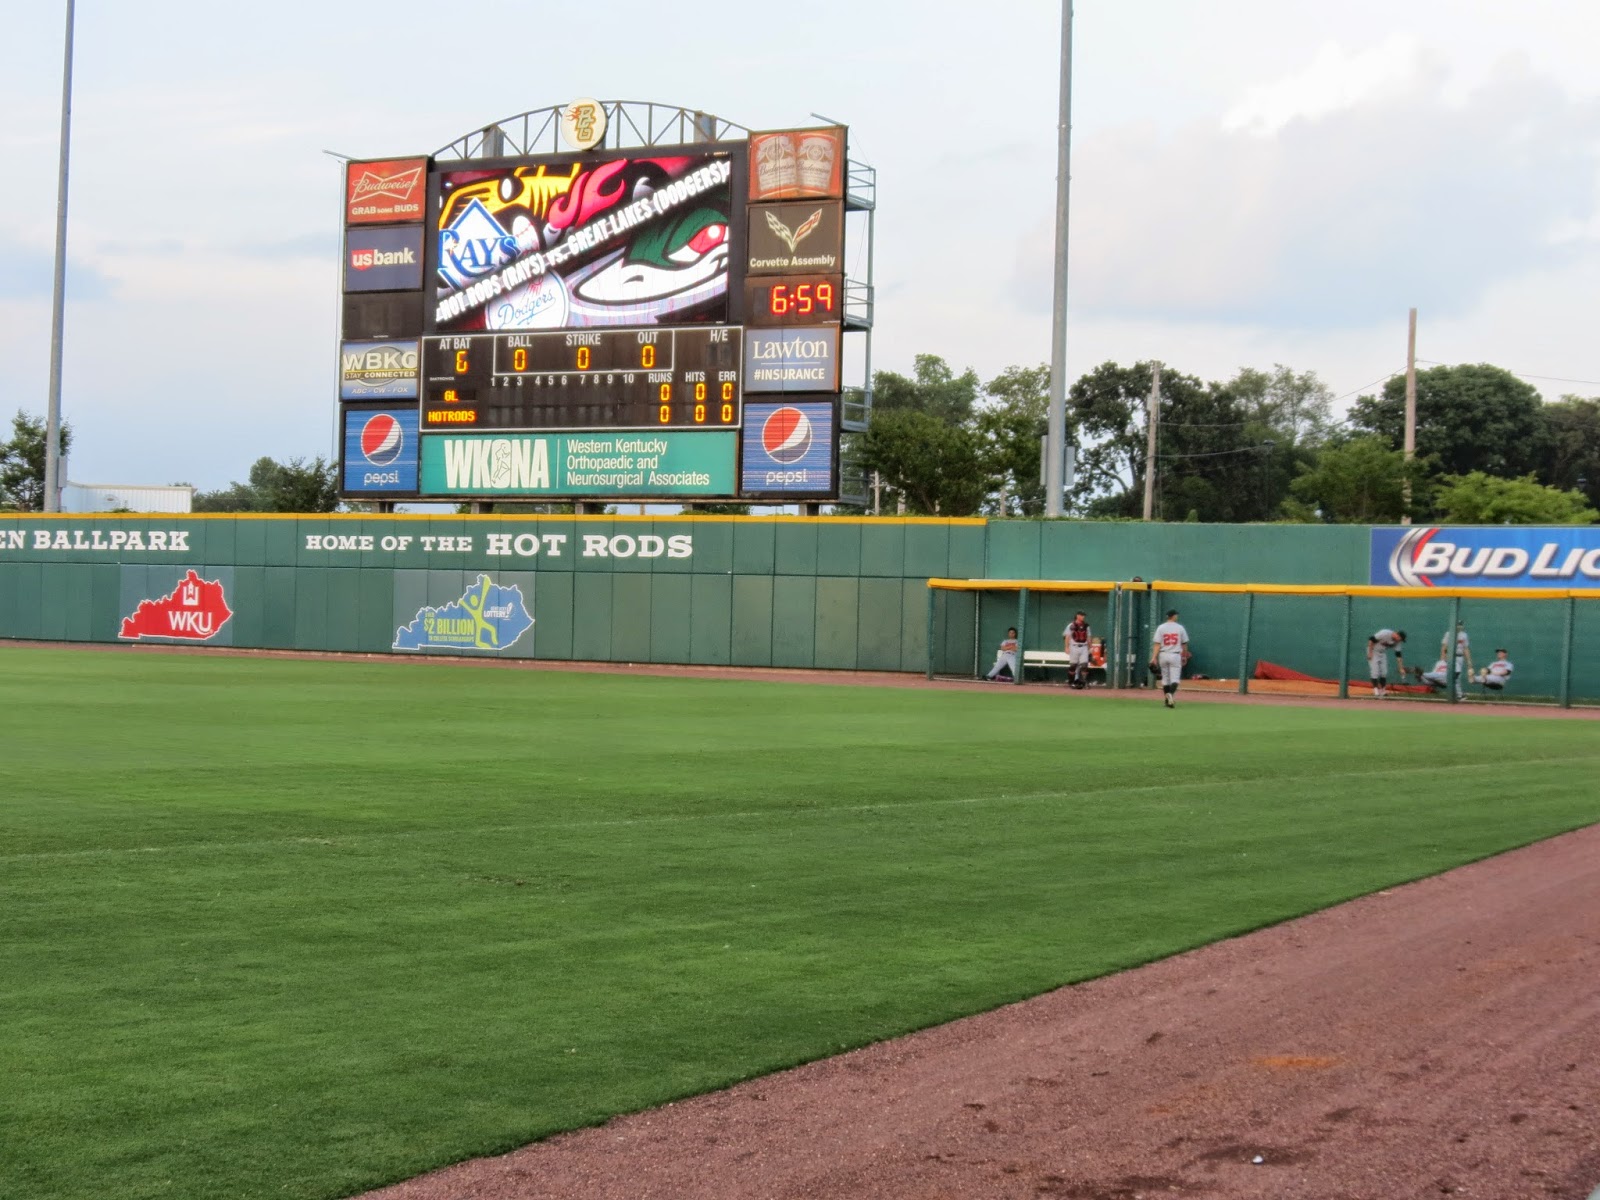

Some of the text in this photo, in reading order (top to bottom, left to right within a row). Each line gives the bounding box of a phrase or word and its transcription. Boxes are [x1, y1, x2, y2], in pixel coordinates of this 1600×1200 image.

[352, 178, 418, 193] Budweiser
[352, 206, 377, 215] GRAB
[394, 203, 419, 213] BUDS
[437, 229, 521, 277] RAYS
[466, 274, 502, 308] RODS
[502, 252, 546, 291] (RAYS)
[567, 216, 610, 256] GREAT
[609, 197, 654, 236] LAKES
[750, 254, 836, 268] Corvette Assembly
[772, 283, 832, 313] 6:59
[497, 288, 557, 328] Dodgers
[439, 337, 471, 350] AT BAT
[507, 335, 533, 348] BALL
[566, 333, 601, 346] STRIKE
[637, 331, 659, 344] OUT
[710, 328, 728, 342] H/E
[642, 344, 655, 368] 0
[753, 336, 829, 359] Lawton
[513, 348, 527, 371] 0
[577, 346, 590, 370] 0
[490, 370, 737, 387] 1 2 3 4 5 6 7 8 9 10 RUNS HITS ERR
[753, 367, 826, 381] #INSURANCE
[443, 389, 460, 402] GL
[660, 383, 671, 401] 0
[695, 383, 706, 401] 0
[427, 404, 732, 423] HOTRODS 0 0 0
[566, 438, 668, 456] Western Kentucky
[443, 438, 550, 490] WKONA
[566, 455, 659, 472] Orthopaedic and
[364, 469, 399, 487] pepsi
[566, 470, 710, 489] Neurosurgical Associates
[765, 469, 809, 487] pepsi
[33, 530, 190, 551] BALLPARK
[305, 533, 693, 559] HOME OF THE HOT RODS
[1411, 542, 1530, 577] BUD
[168, 610, 213, 635] WKU
[423, 617, 475, 635] $2 BILLION
[1163, 632, 1179, 646] 25
